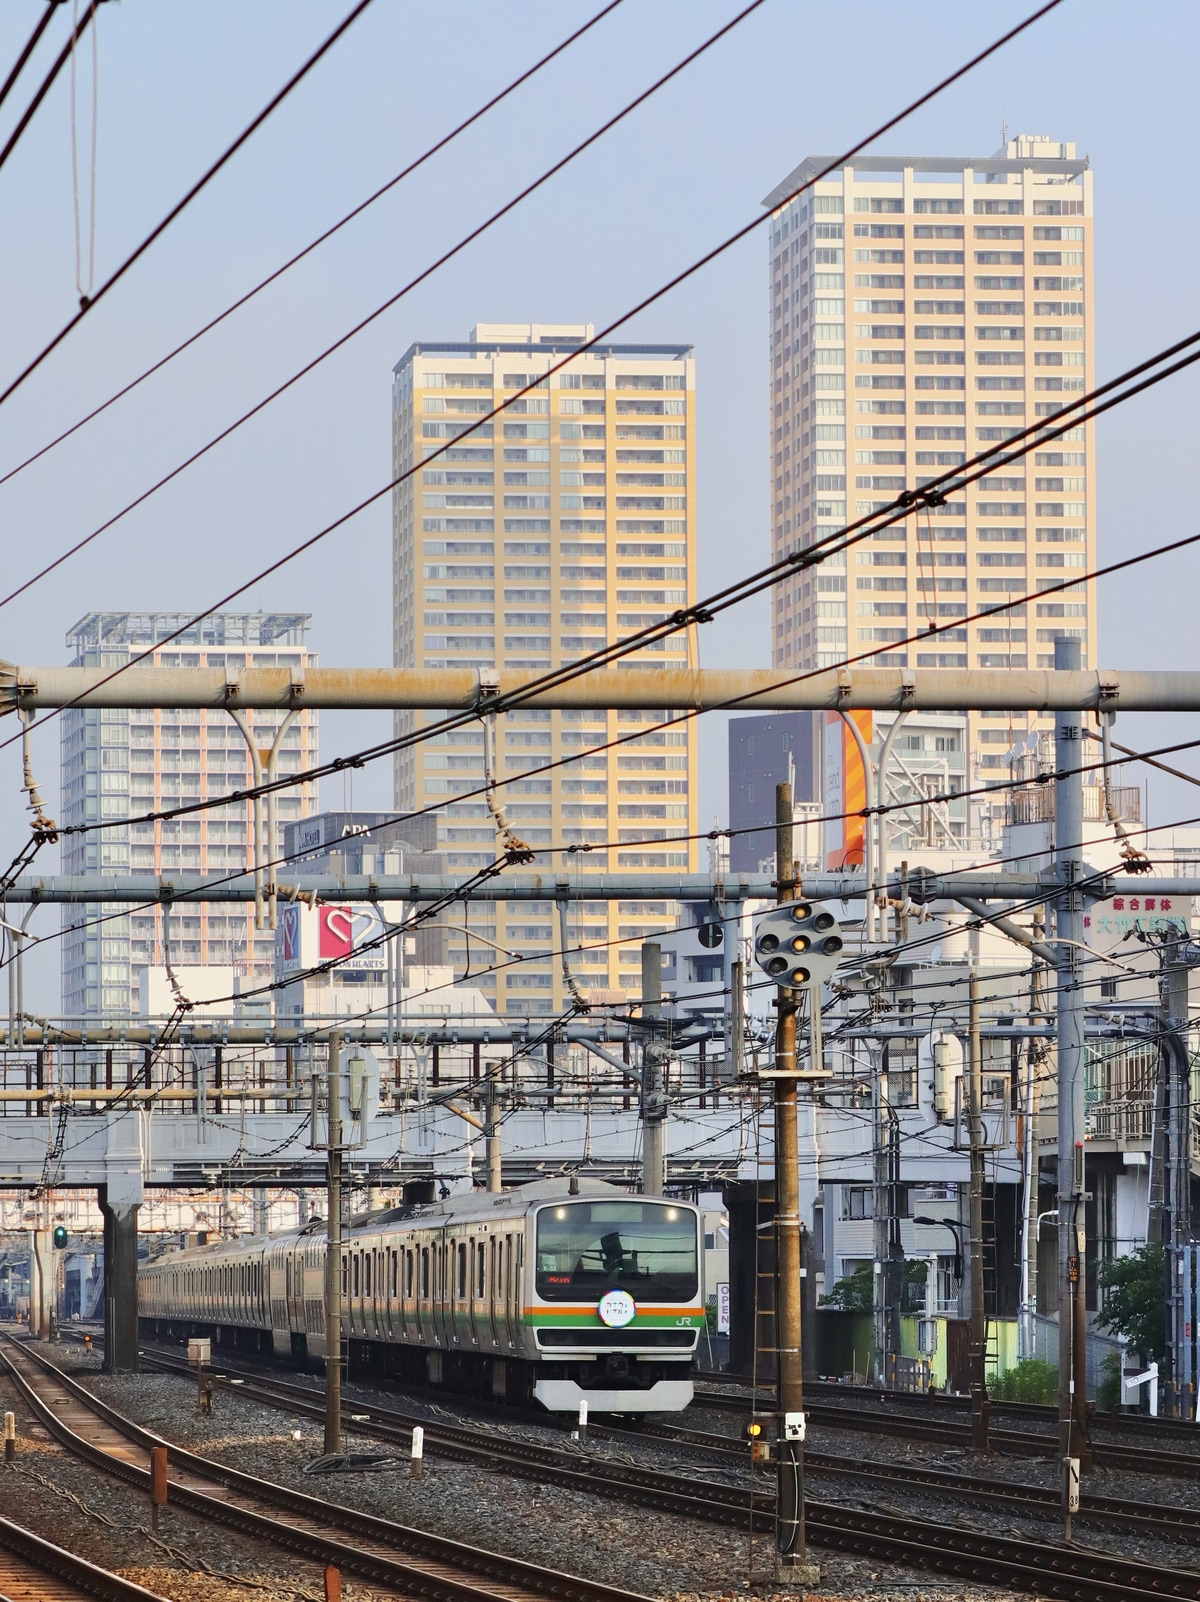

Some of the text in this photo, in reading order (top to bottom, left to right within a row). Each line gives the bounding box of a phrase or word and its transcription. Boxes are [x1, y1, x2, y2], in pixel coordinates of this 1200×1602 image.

[341, 824, 371, 837] APA
[720, 1285, 730, 1324] OPEN
[676, 1317, 691, 1326] JR
